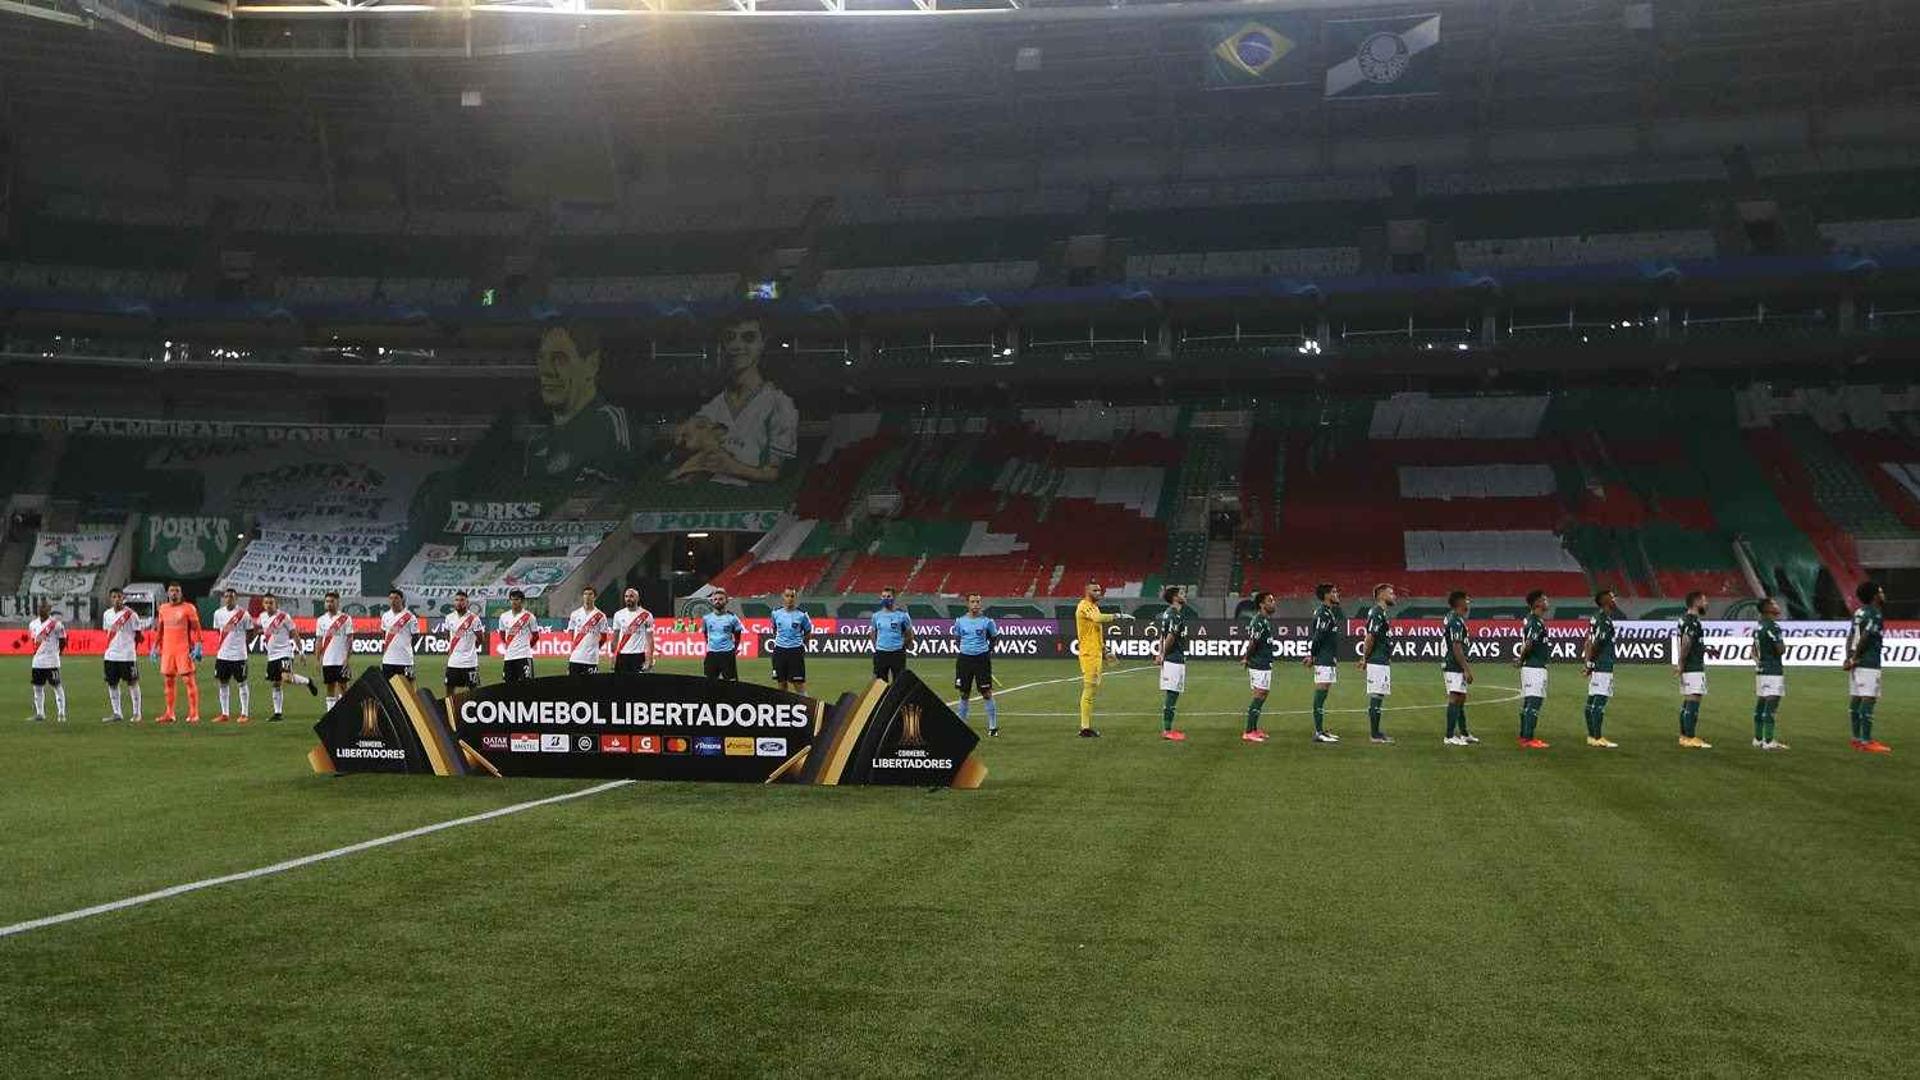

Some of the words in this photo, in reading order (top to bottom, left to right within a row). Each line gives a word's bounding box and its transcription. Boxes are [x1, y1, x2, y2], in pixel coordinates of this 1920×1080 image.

[148, 516, 230, 553] PORK'S
[841, 625, 872, 635] QATA
[823, 639, 876, 653] AIRWA
[460, 700, 607, 724] CONMEBOL
[611, 702, 809, 727] LIBERTADORES
[483, 737, 508, 746] QATAR
[336, 748, 405, 760] LIBERTADORES
[872, 758, 952, 769] LIBERTADORES
